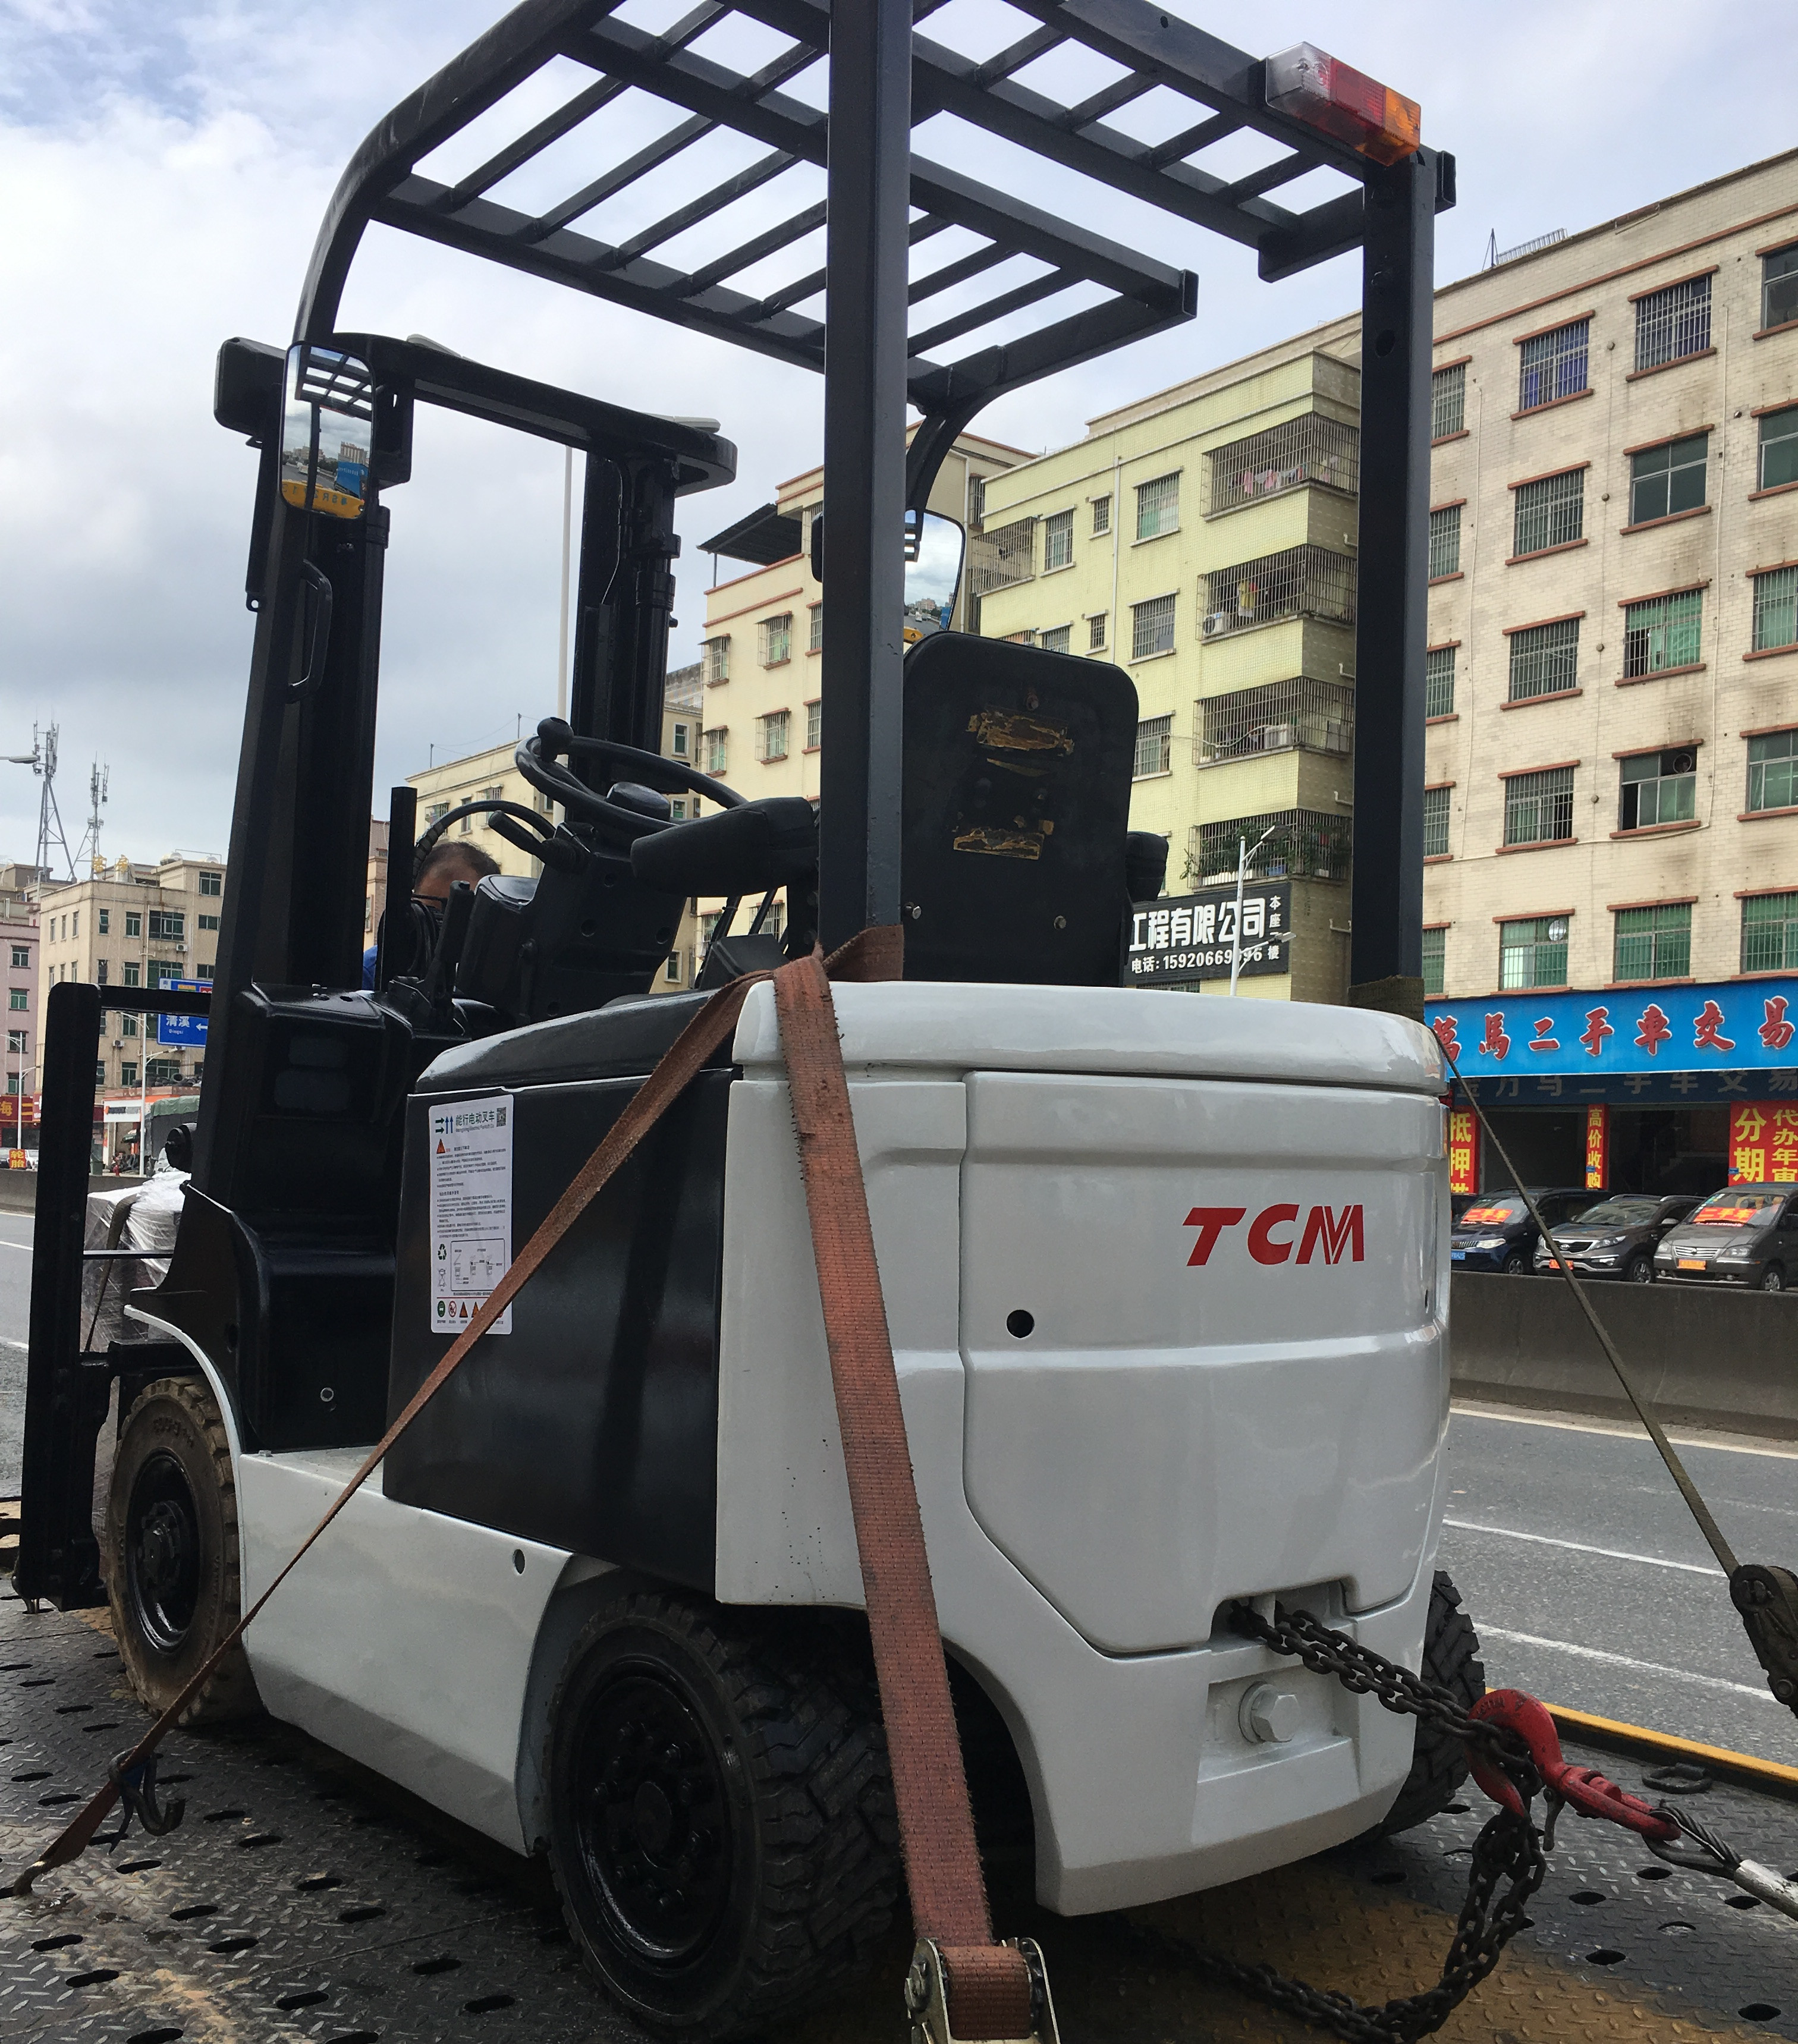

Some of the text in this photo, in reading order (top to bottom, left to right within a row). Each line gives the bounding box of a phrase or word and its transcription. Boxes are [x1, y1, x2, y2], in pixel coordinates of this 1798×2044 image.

[1129, 898, 1265, 952] 工程有限公司
[455, 1110, 495, 1126] 能行电动叉车
[1733, 1108, 1766, 1182] 分期
[11, 1150, 24, 1168] 轮胎
[1587, 1108, 1602, 1188] 高价收购
[1182, 1203, 1365, 1266] TCM
[1699, 1208, 1753, 1219] 二手车
